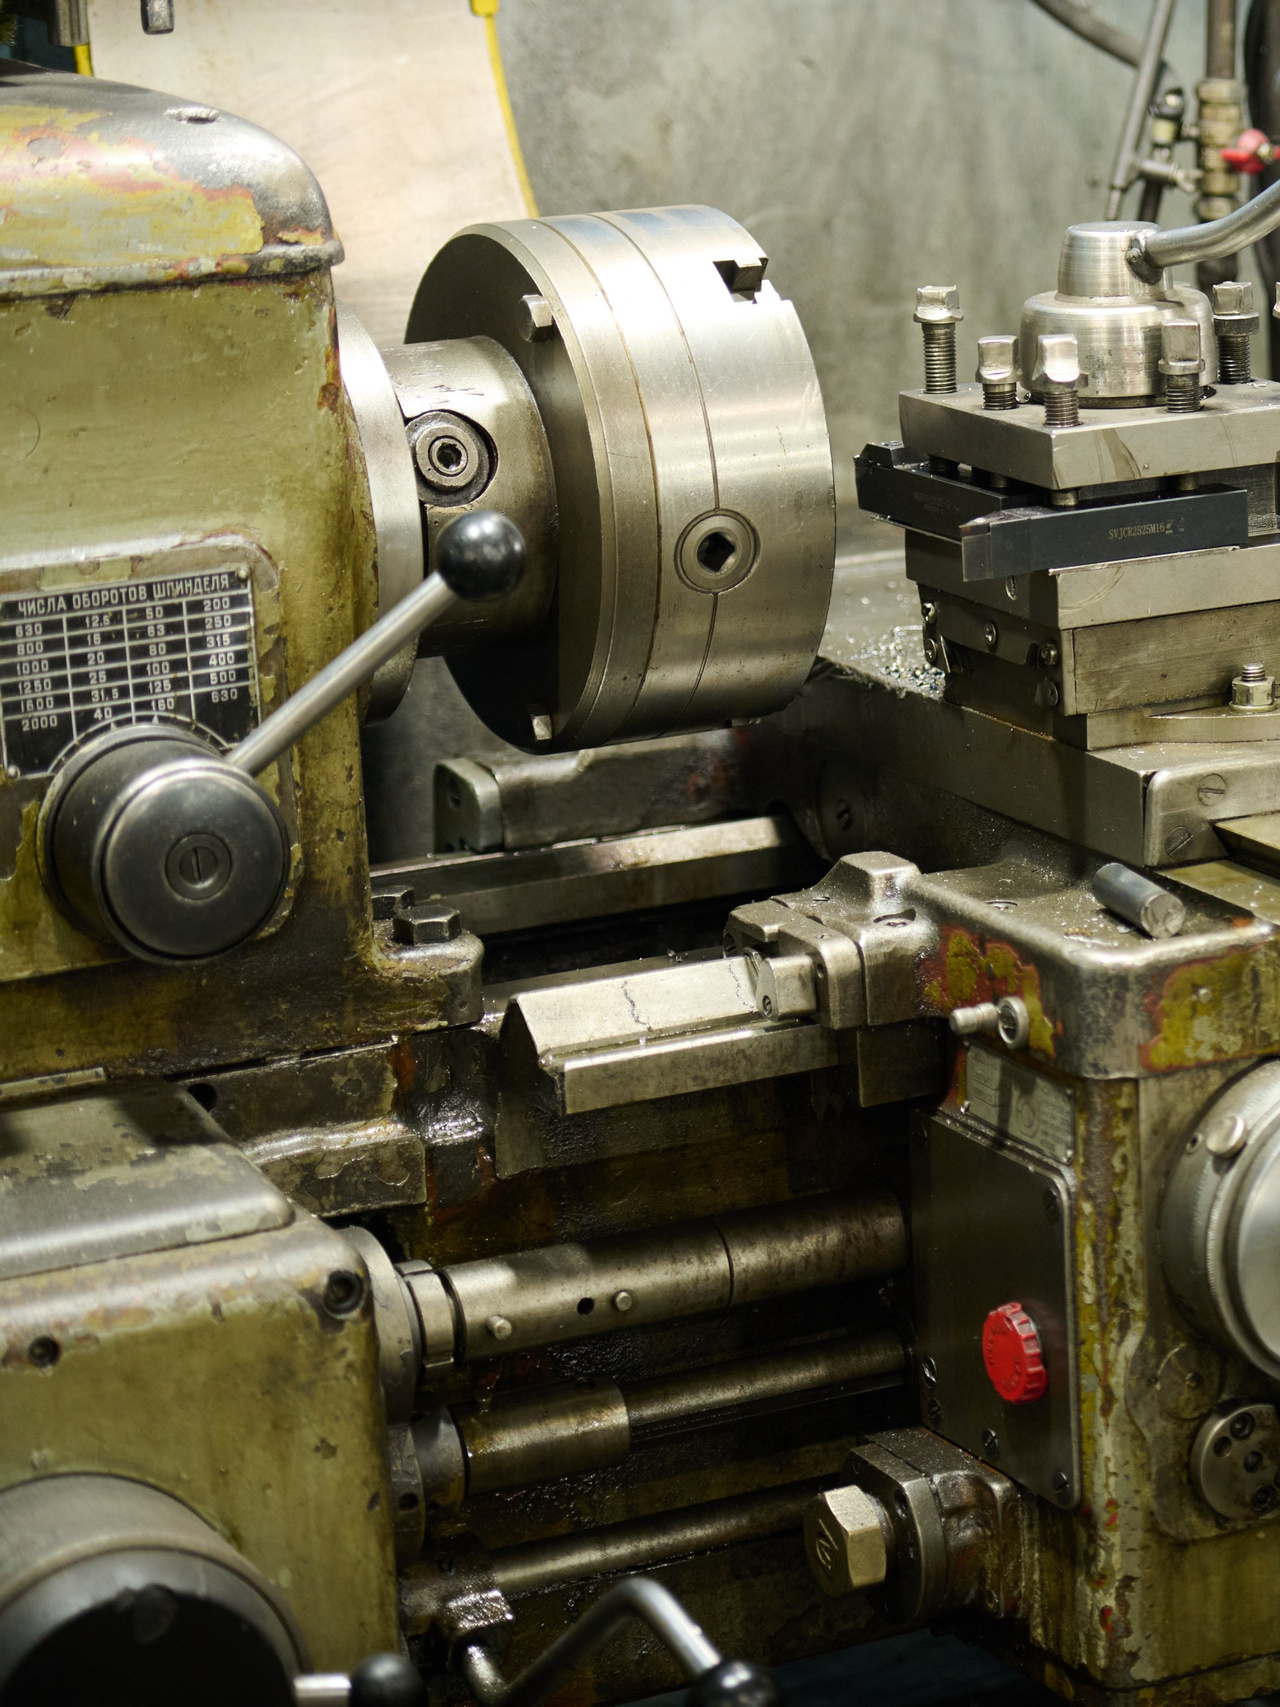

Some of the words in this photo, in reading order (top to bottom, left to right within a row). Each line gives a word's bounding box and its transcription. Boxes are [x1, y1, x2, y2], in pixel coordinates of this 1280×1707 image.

[1108, 522, 1166, 540] SVJCR2525M16
[18, 596, 67, 616] ЧИСЛА
[72, 585, 147, 610] ОБОРОТОВ
[152, 574, 230, 599] ШПИНДЕЛЯ
[15, 623, 42, 638] 630
[145, 606, 163, 620] 50
[203, 597, 230, 612] 200
[17, 642, 44, 656] 800
[87, 633, 101, 646] 16
[147, 624, 165, 637] 63
[205, 614, 232, 629] 250
[17, 660, 49, 675] 1000
[87, 652, 105, 666] 20
[149, 643, 166, 656] 80
[206, 633, 230, 648] 315
[18, 678, 52, 694] 1250
[89, 670, 107, 684] 25
[146, 661, 170, 676] 100
[209, 652, 235, 666] 400
[21, 696, 54, 712] 1600
[148, 679, 171, 694] 125
[210, 670, 236, 685] 500
[22, 715, 58, 732] 2000
[94, 707, 113, 720] 40
[151, 698, 175, 712] 160
[211, 688, 238, 703] 630
